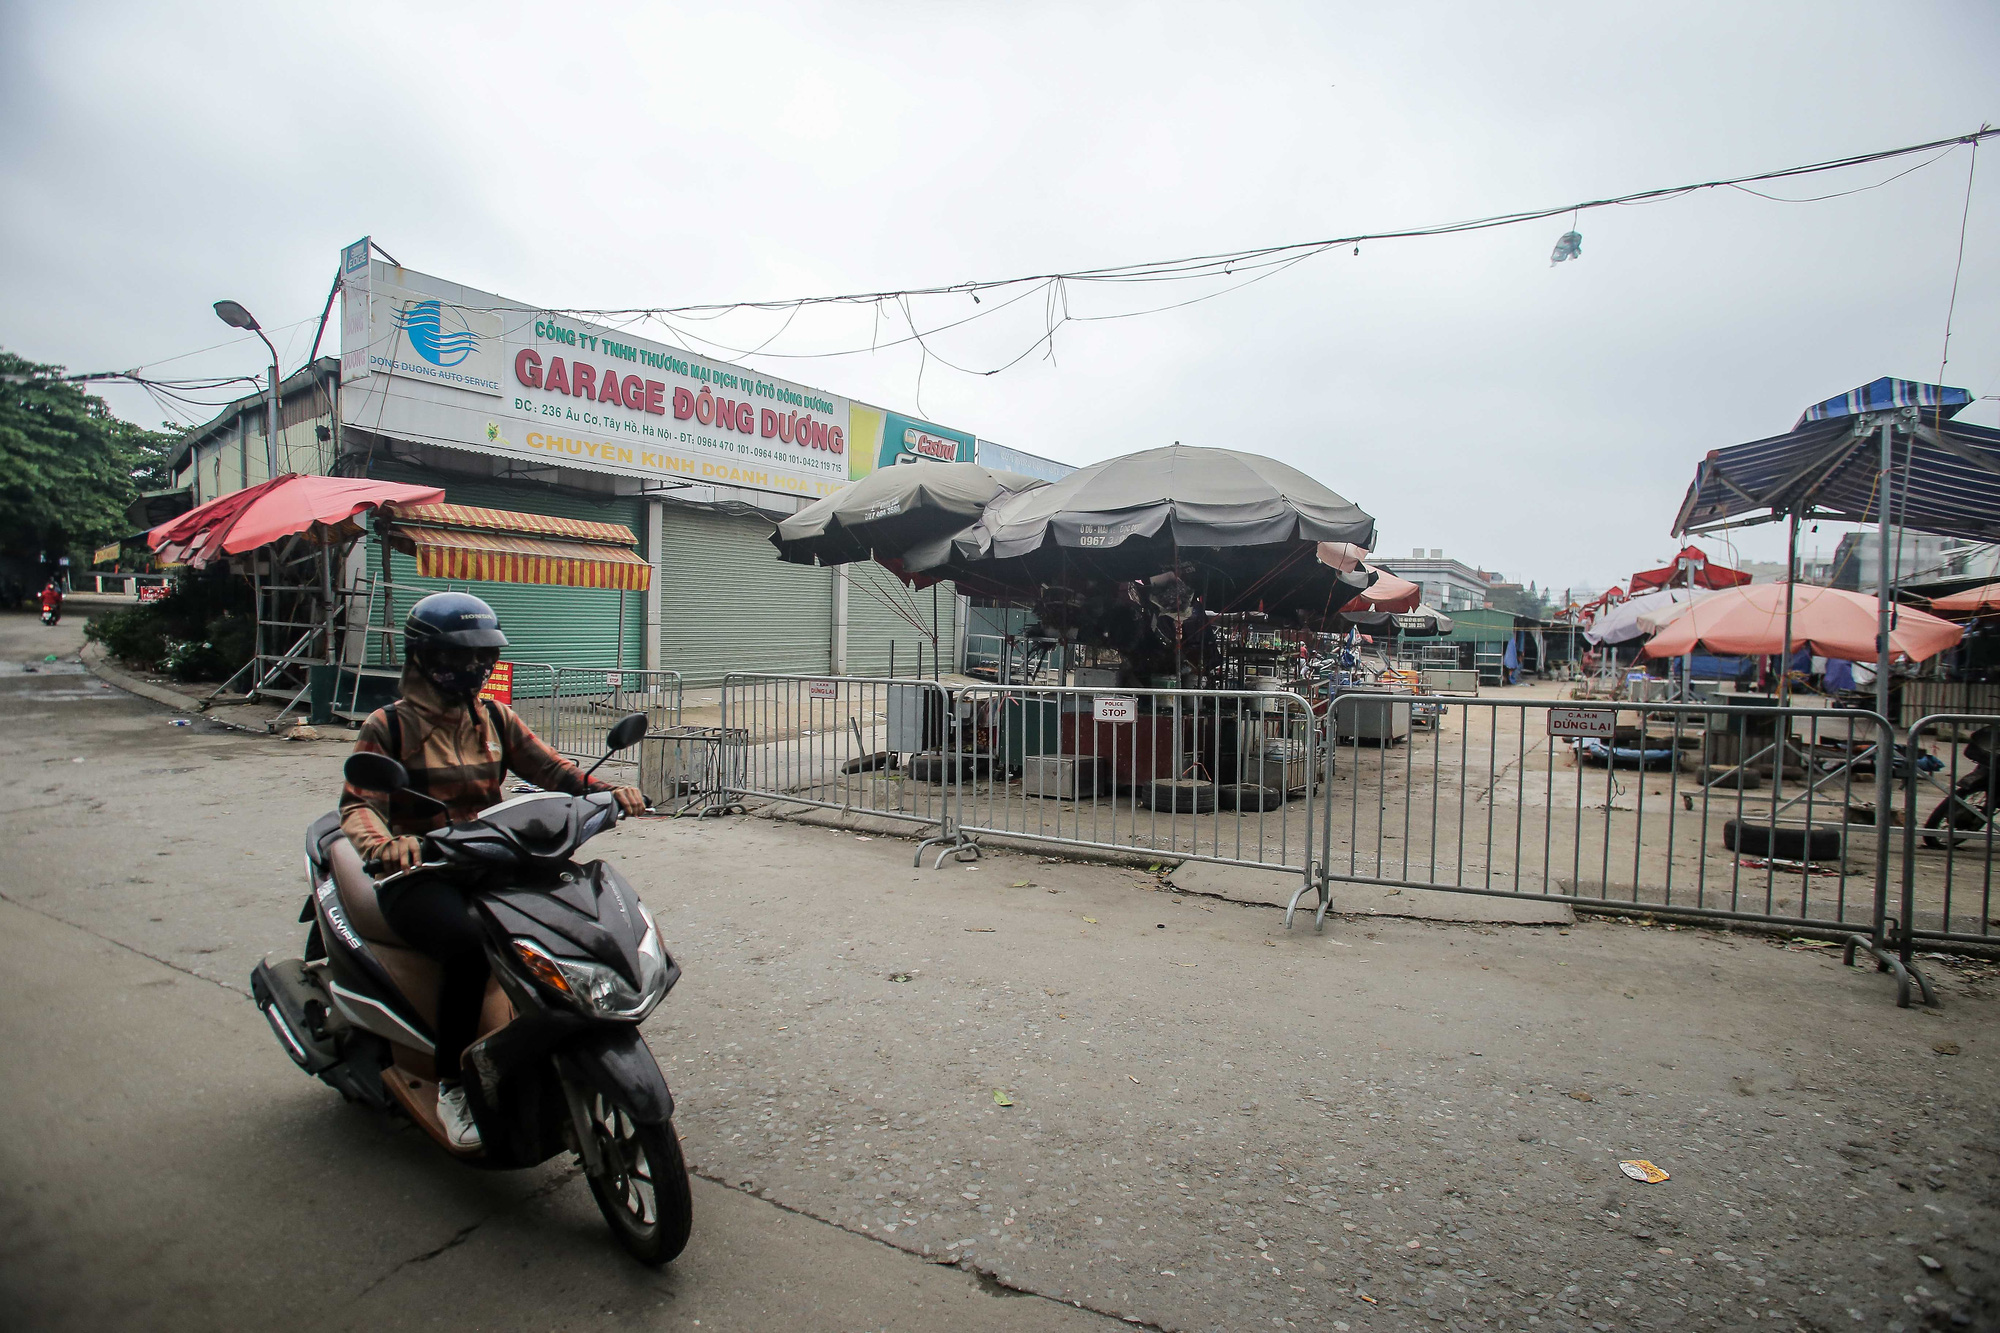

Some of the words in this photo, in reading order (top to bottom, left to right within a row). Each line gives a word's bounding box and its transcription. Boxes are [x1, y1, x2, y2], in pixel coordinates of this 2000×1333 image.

[401, 363, 437, 377] DUONG
[438, 371, 463, 383] AUTO
[464, 376, 500, 390] SERVICE
[535, 320, 576, 346] CÔNG
[578, 332, 599, 351] TY
[601, 339, 638, 363] TNHH
[640, 350, 689, 376] THƯƠNG
[690, 363, 711, 385] MẠI
[713, 370, 738, 389] DỊCH
[740, 377, 754, 396] VỤ
[755, 380, 775, 399] ÔTÔ
[803, 395, 834, 415] DƯƠNG
[514, 348, 665, 415] GARAGE
[673, 385, 755, 435] ĐÔNG
[761, 408, 844, 455] DƯƠNG
[541, 404, 562, 418] 236
[565, 406, 580, 422] Âu
[603, 417, 621, 432] Tây
[624, 420, 640, 435] Hồ,
[642, 425, 655, 437] Hà
[697, 436, 717, 449] 0964
[719, 440, 735, 452] 470
[773, 451, 787, 462] 480
[820, 461, 831, 471] 119
[832, 463, 842, 473] 715
[917, 434, 956, 461] Castrol
[526, 432, 633, 464] CHUYÊN
[641, 451, 695, 474] KINH
[702, 462, 768, 486] DOANH
[774, 475, 809, 493] HOA
[1080, 536, 1106, 546] 0967
[1101, 708, 1127, 717] STOP
[1553, 718, 1588, 730] DỪNG
[1590, 722, 1611, 733] LẠI
